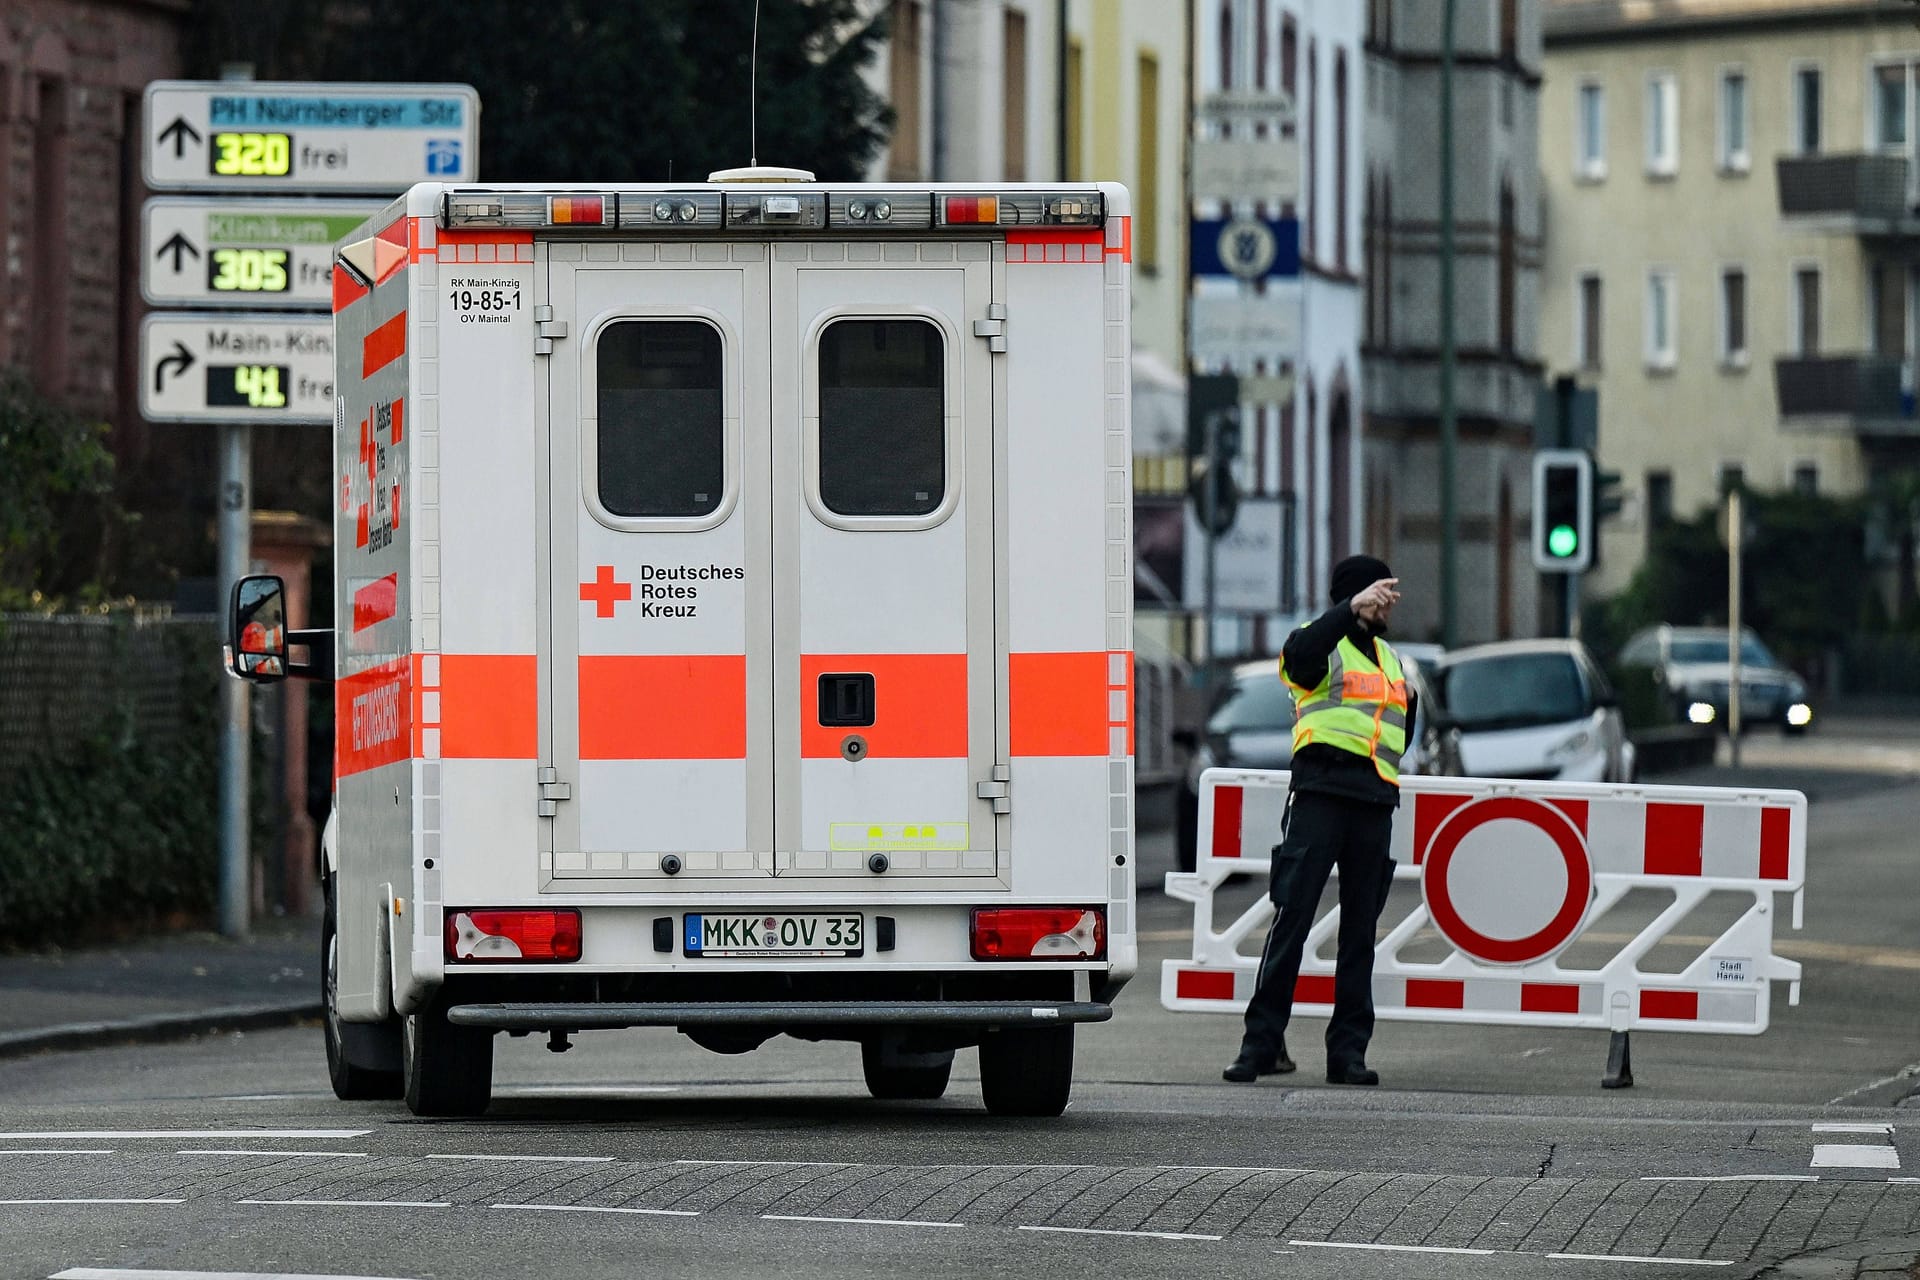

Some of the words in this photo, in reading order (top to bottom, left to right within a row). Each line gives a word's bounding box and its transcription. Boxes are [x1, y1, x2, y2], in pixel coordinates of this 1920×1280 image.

[211, 98, 247, 123] PH
[256, 97, 406, 129] Nürnberger
[215, 132, 290, 175] 320
[301, 147, 348, 169] frei
[208, 214, 328, 241] Klinikum
[213, 248, 287, 291] 305
[451, 278, 465, 287] RK
[467, 278, 520, 289] Main-Kinzig
[450, 290, 520, 311] 19-85-1
[460, 314, 476, 323] OV
[478, 314, 511, 323] Maintal
[207, 330, 332, 353] Main-Kin
[235, 364, 286, 407] 41
[299, 376, 334, 400] fre
[640, 564, 745, 580] Deutsches
[641, 583, 697, 599] Rotes
[641, 602, 697, 618] Kreuz
[704, 918, 760, 946] MKK
[780, 918, 818, 946] OV
[825, 918, 860, 946] 33
[1716, 970, 1745, 981] Hanau
